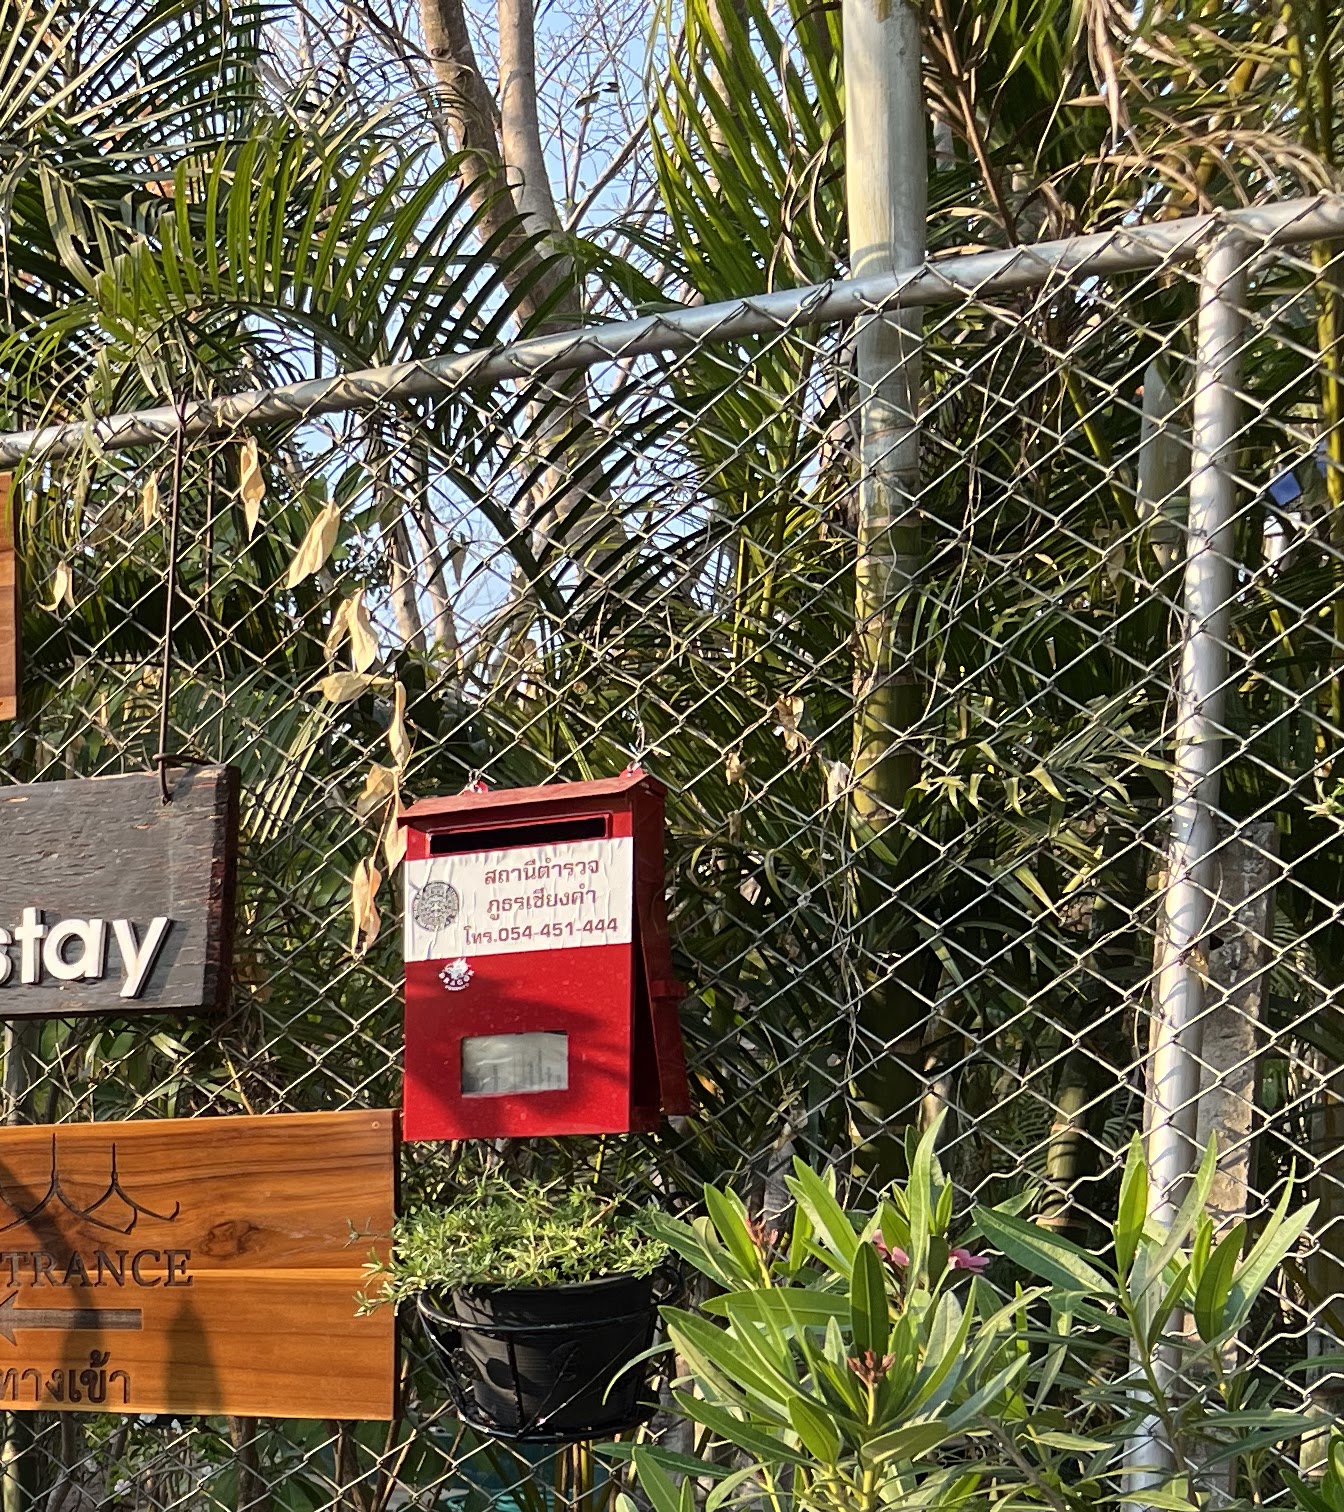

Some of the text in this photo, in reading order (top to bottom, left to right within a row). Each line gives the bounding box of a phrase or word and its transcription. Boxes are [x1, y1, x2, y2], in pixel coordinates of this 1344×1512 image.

[484, 857, 600, 886] สถานีตำรวจ
[486, 883, 598, 921] ภูธรเชียงคำ
